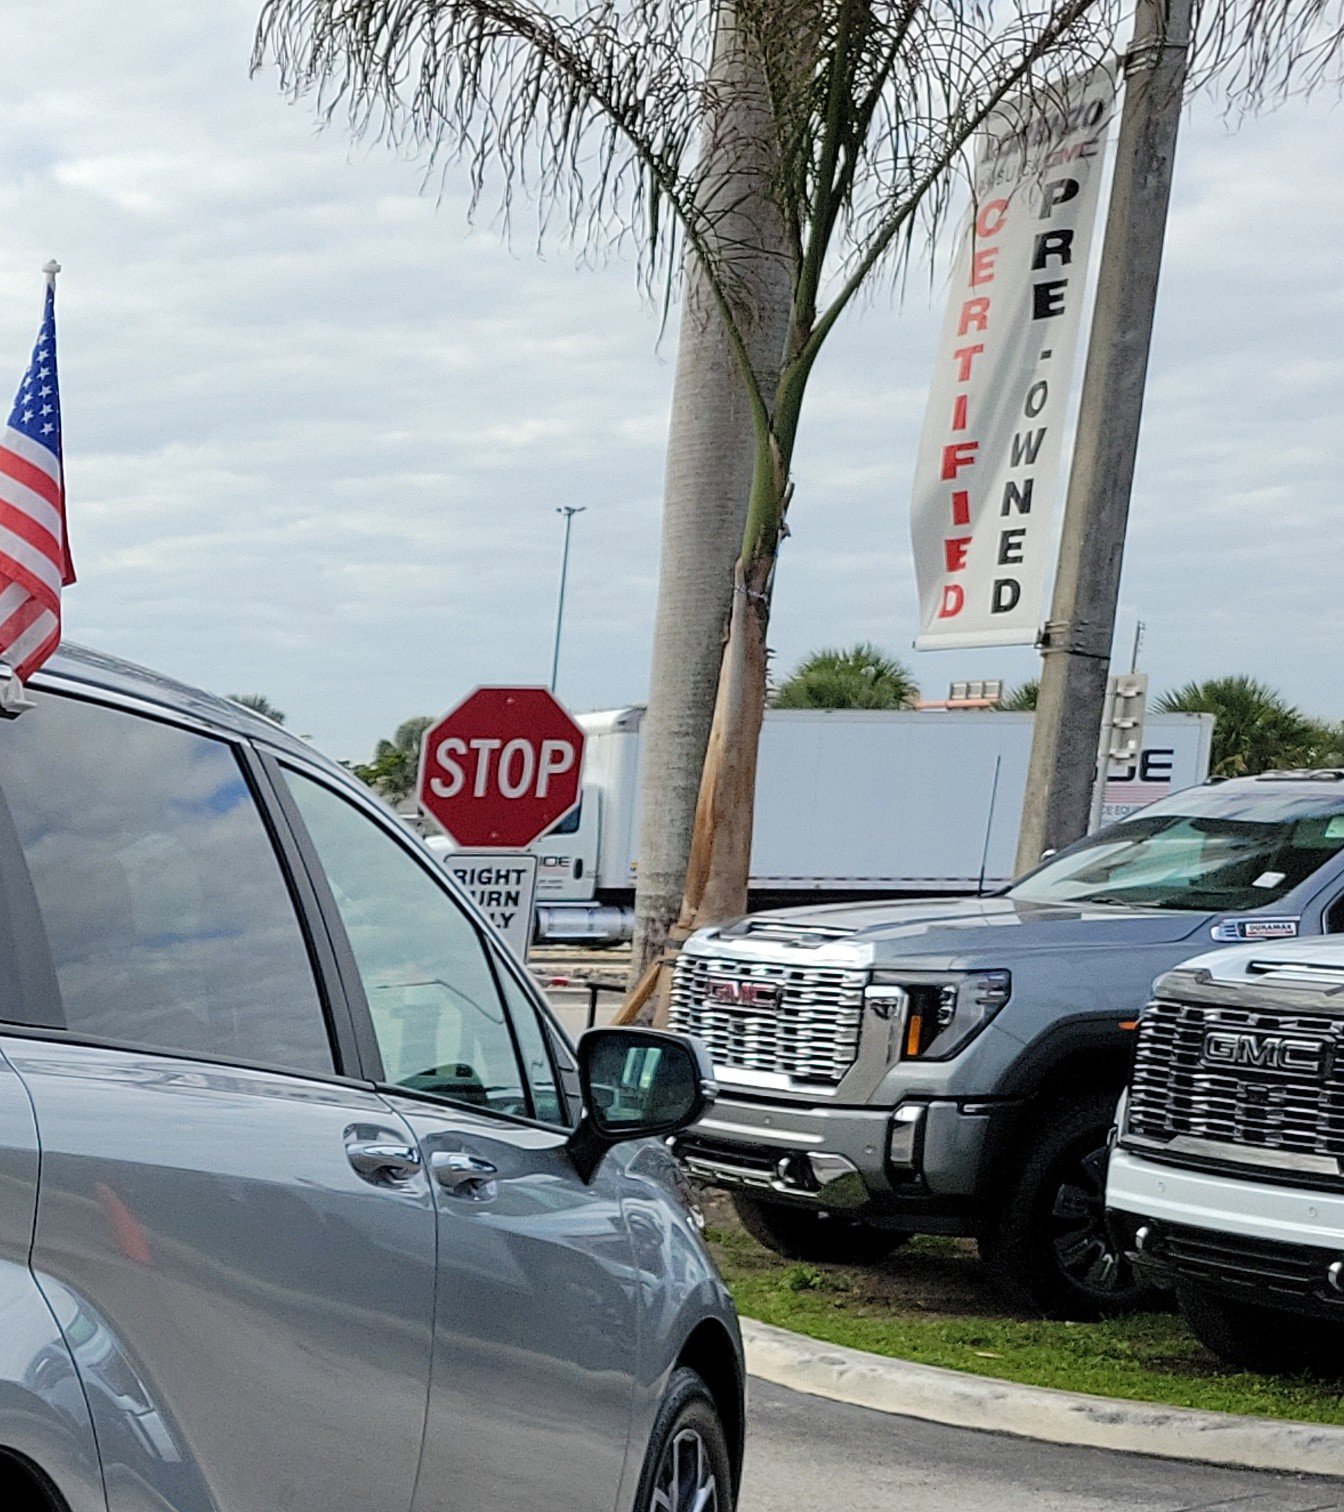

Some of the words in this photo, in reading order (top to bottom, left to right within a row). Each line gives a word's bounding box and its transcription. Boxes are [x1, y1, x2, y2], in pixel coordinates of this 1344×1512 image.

[938, 198, 1008, 619] CERTIFIED
[430, 737, 575, 798] STOP
[470, 890, 521, 907] URN
[1204, 1031, 1323, 1072] GMC
